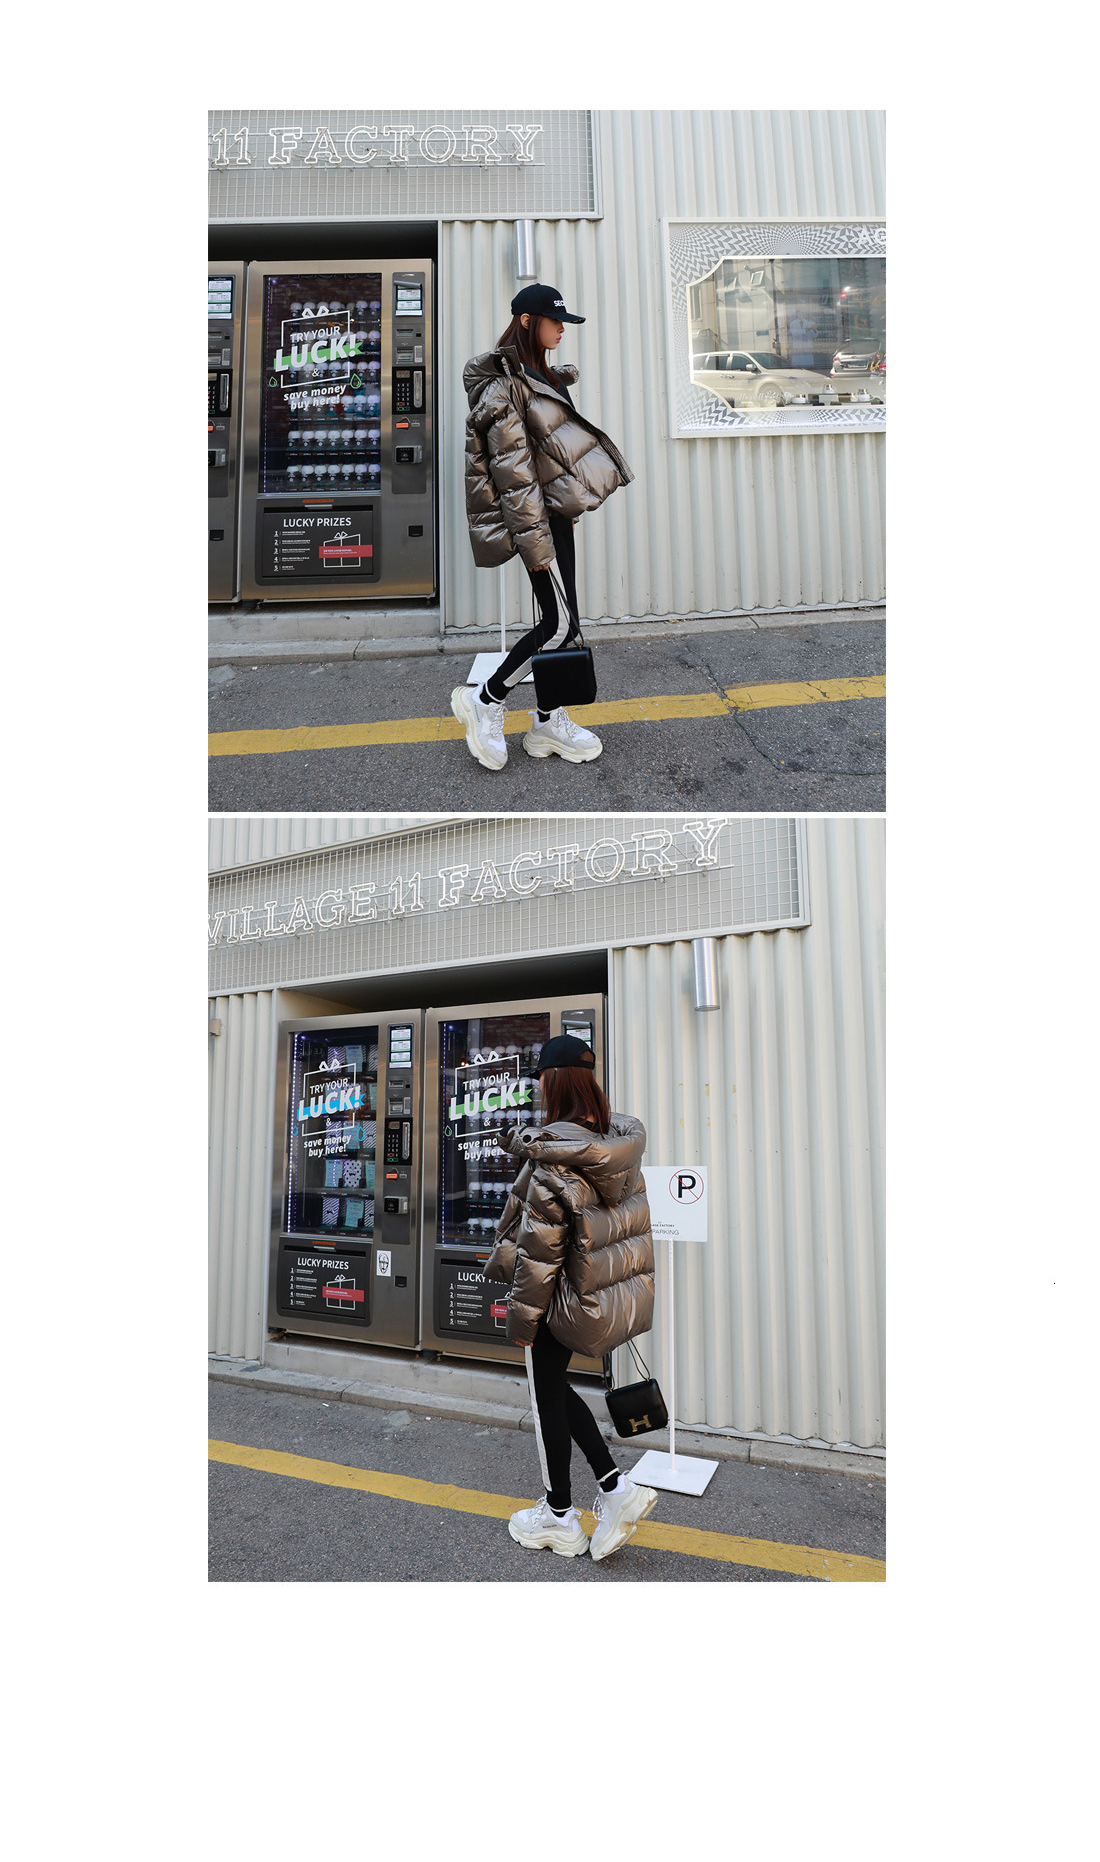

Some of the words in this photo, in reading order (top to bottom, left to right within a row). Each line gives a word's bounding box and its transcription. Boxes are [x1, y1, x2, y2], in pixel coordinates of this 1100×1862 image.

[213, 128, 251, 165] 11
[269, 125, 542, 164] FACTORY
[290, 331, 310, 343] TRY
[311, 326, 340, 339] YOUR
[275, 334, 356, 372] LUCK!
[312, 368, 320, 377] &
[283, 390, 308, 401] save
[311, 384, 347, 397] money
[290, 400, 310, 410] buy
[313, 394, 340, 407] here!
[283, 518, 315, 528] LUCKY
[317, 517, 352, 527] PRIZES
[391, 872, 424, 914] 11
[438, 818, 727, 907] FACTORY
[309, 1084, 324, 1094] TRY
[326, 1078, 348, 1090] YOUR
[463, 1078, 481, 1091] TRY
[483, 1071, 510, 1086] YOUR
[298, 1085, 361, 1121] LUCK!
[450, 1080, 526, 1121] LUCK!
[326, 1118, 332, 1126] &
[483, 1117, 491, 1126] &
[304, 1138, 322, 1148] save
[323, 1135, 351, 1145] money
[458, 1140, 480, 1151] save
[308, 1148, 323, 1158] buy
[325, 1144, 347, 1155] here!
[464, 1151, 482, 1161] buy
[297, 1257, 320, 1268] LUCKY
[322, 1259, 349, 1270] PRIZES
[457, 1272, 486, 1283] LUCKY
